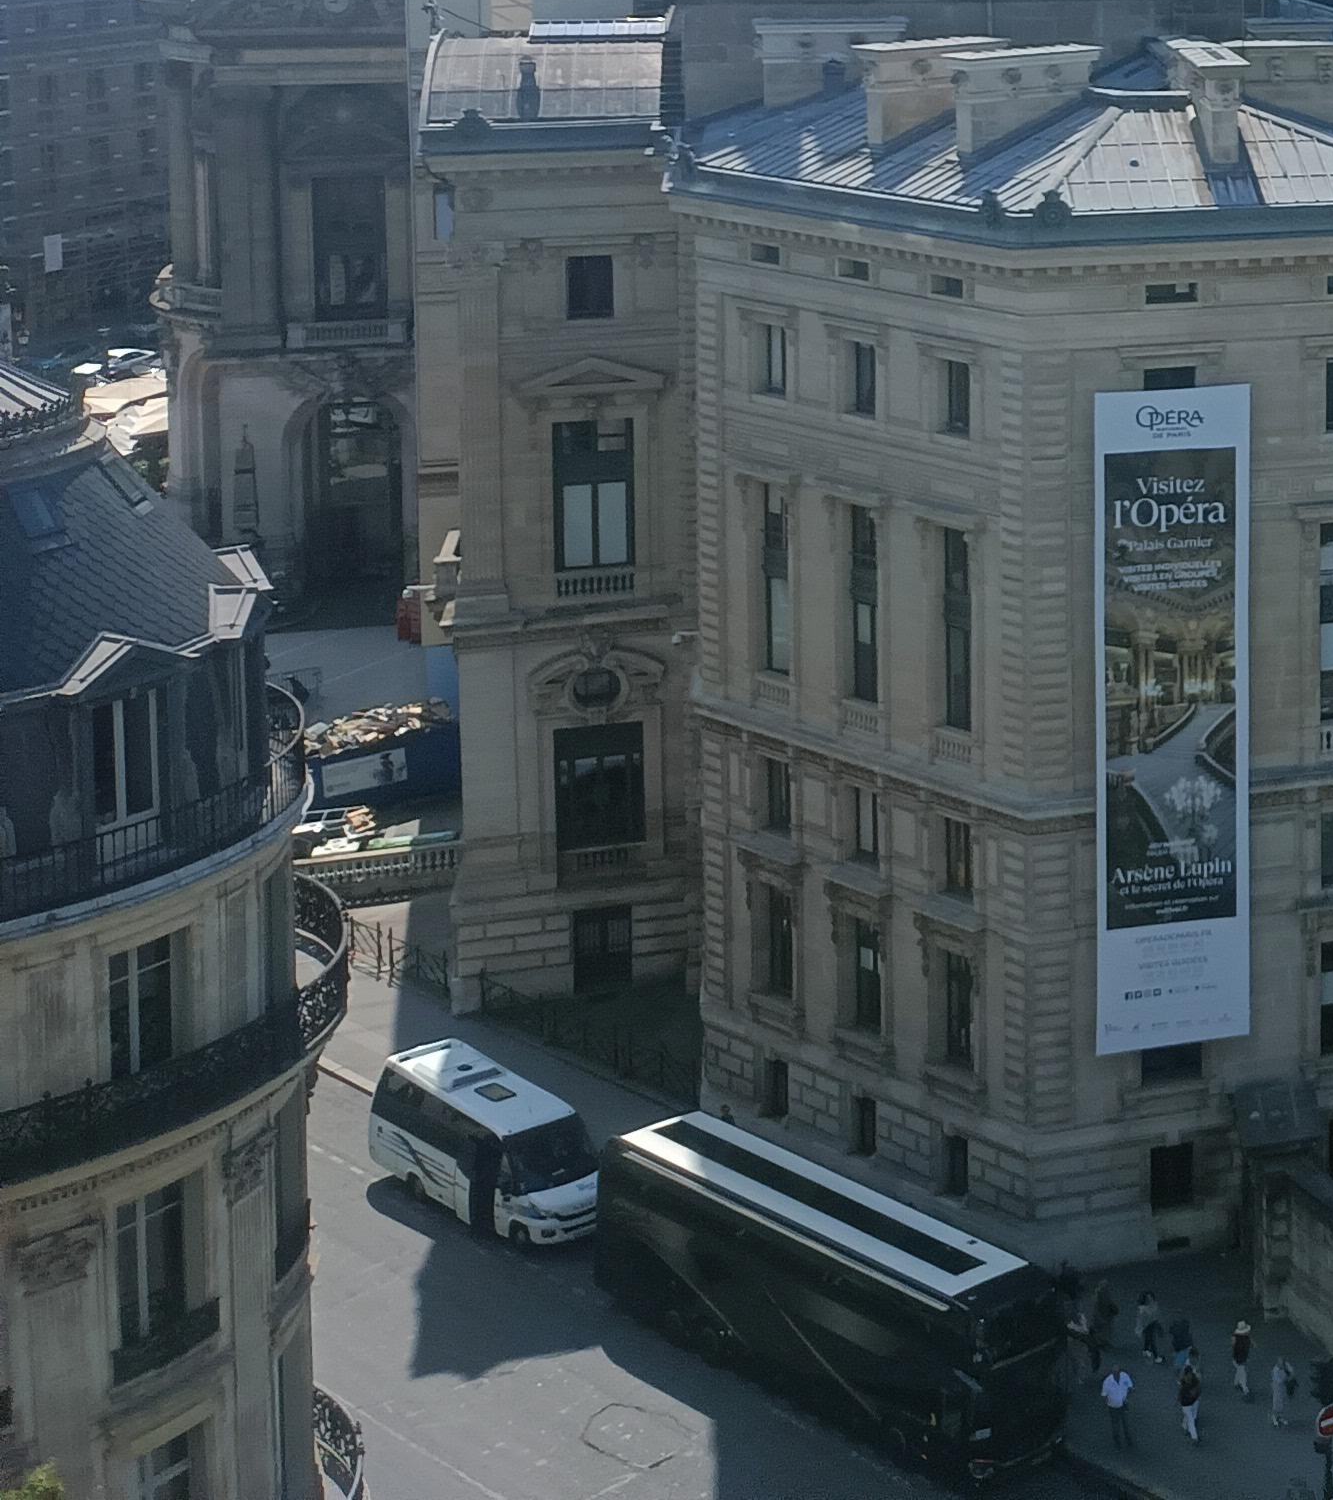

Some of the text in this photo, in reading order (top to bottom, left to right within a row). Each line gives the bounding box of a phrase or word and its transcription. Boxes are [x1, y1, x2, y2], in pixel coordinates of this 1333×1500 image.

[1135, 405, 1206, 431] OPÉRA
[1136, 476, 1205, 496] Visitez
[1113, 496, 1228, 533] l'Opéra
[1127, 537, 1214, 552] Palais Garnier
[1111, 857, 1232, 885] Arsène Lupin
